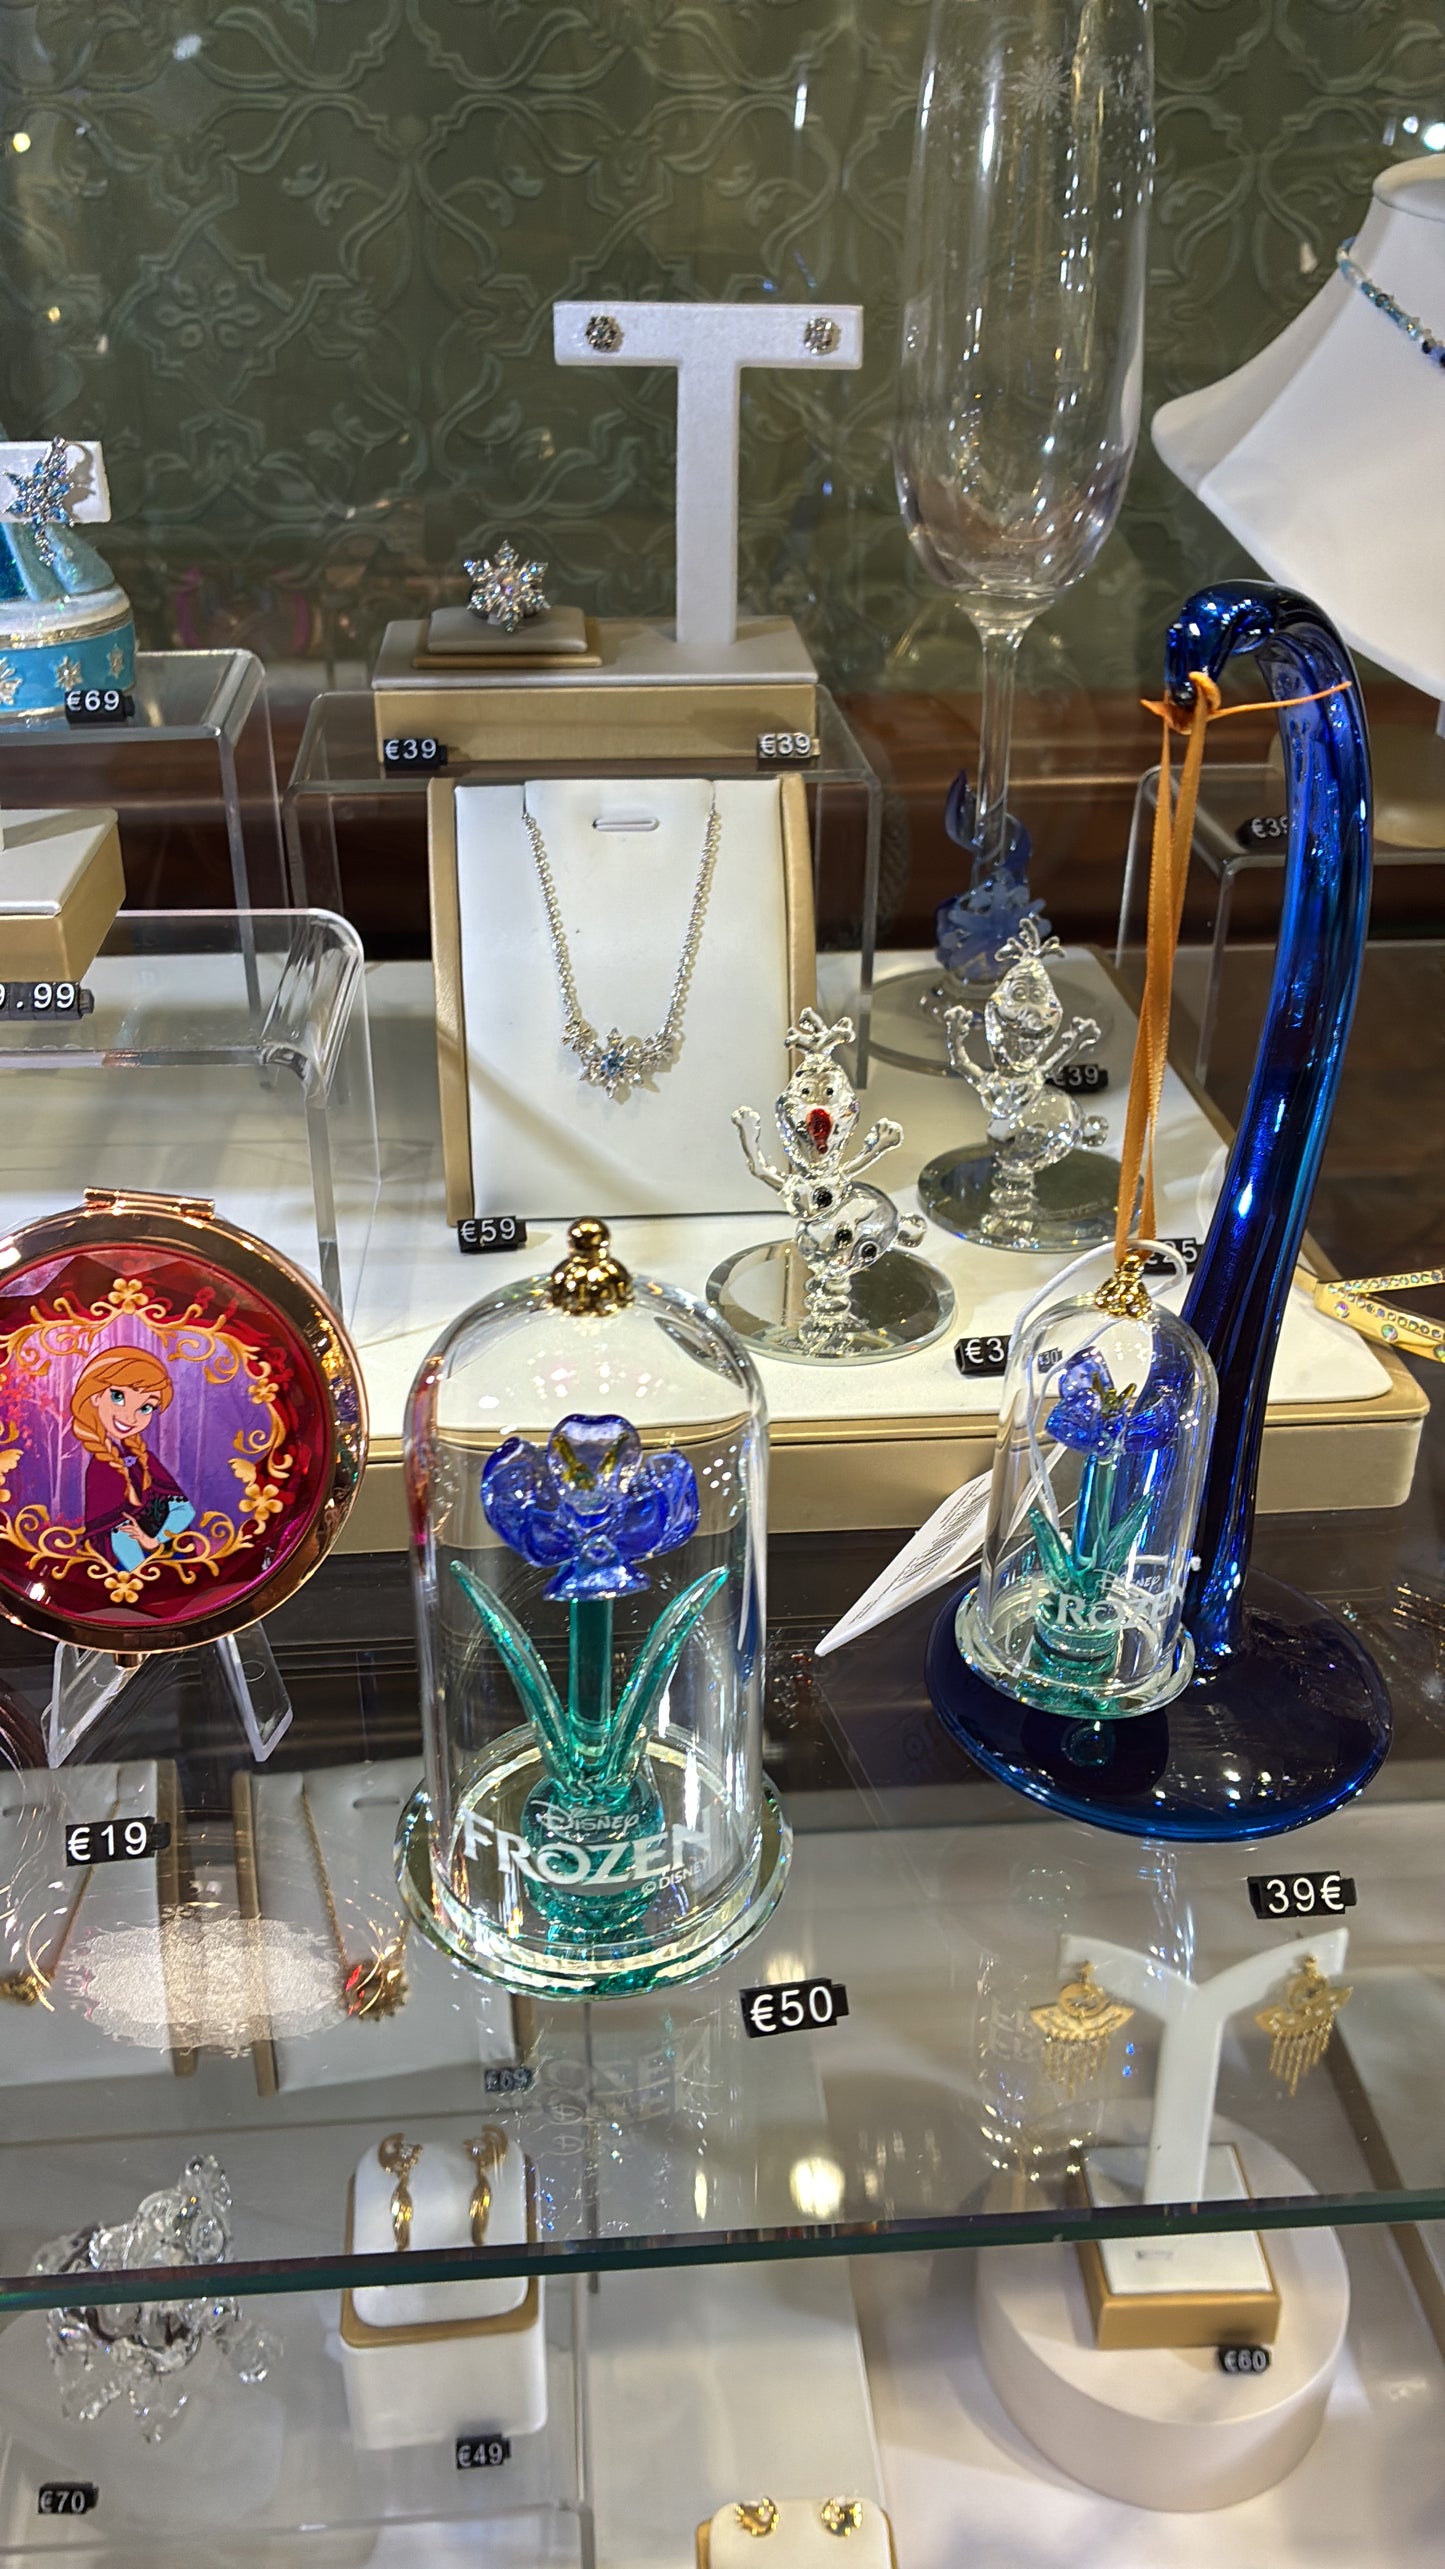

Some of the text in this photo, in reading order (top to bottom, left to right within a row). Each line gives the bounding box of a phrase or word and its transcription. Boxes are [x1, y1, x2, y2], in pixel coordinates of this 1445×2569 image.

[66, 690, 120, 711] €69
[385, 739, 437, 760] €39
[760, 733, 812, 755] €39
[460, 1218, 517, 1243] €59
[1146, 1240, 1197, 1265] 25
[530, 1798, 639, 1834] DISNEY
[67, 1820, 149, 1861] €19
[461, 1803, 713, 1885] FROZEN
[1267, 1873, 1345, 1912] 39€
[750, 1985, 833, 2032] €50
[1225, 2350, 1267, 2371] €60
[458, 2443, 503, 2466] €49
[40, 2489, 86, 2512] €70
